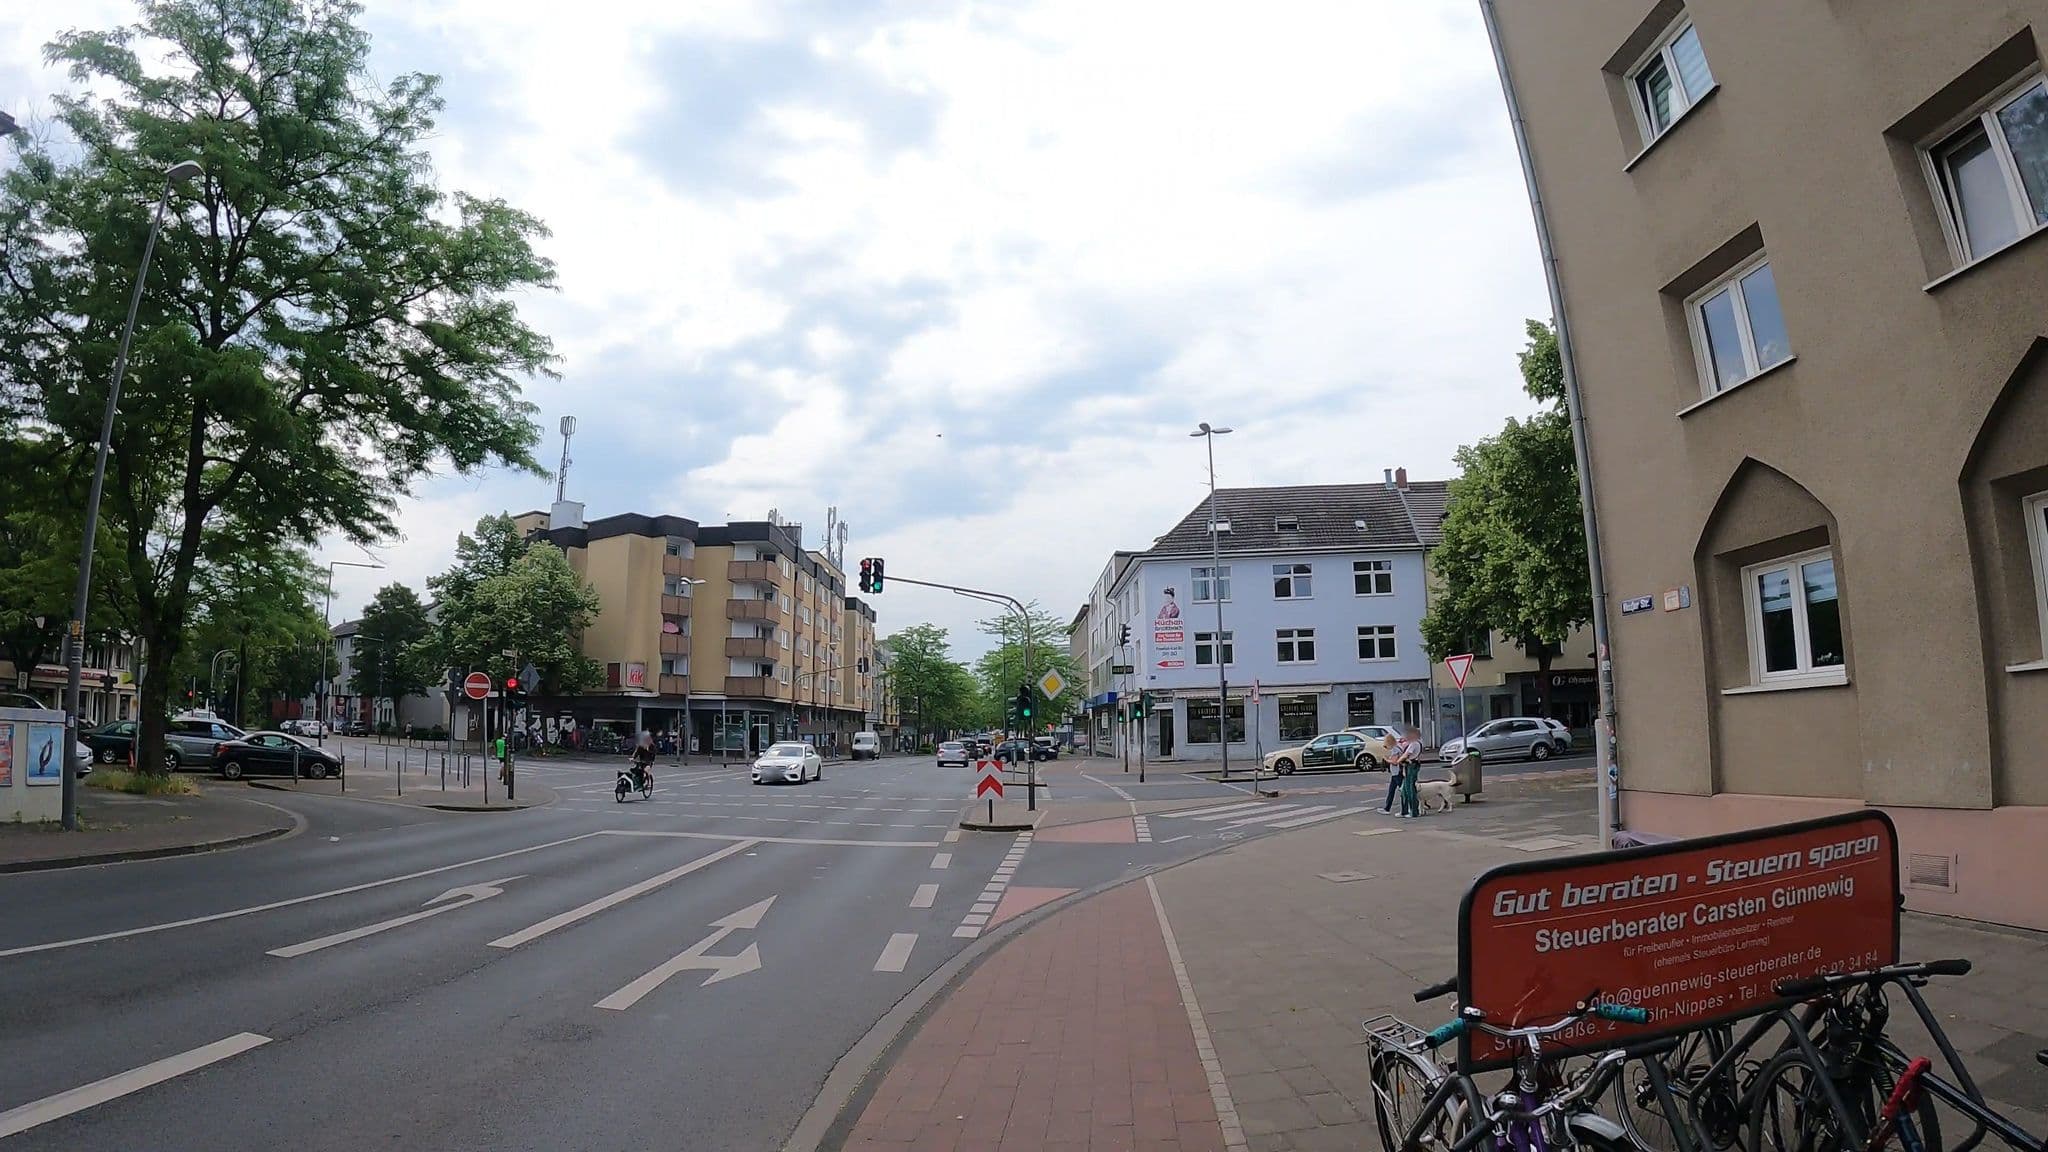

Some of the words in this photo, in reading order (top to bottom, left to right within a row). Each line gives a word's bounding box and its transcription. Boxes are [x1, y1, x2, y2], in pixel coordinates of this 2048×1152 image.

[1492, 887, 1551, 917] Gut
[1561, 873, 1678, 908] beraten
[1705, 851, 1801, 885] Steuern
[1808, 835, 1878, 868] sparen
[1535, 911, 1687, 952] Steuerberater
[1693, 896, 1766, 926] Carsten
[1772, 874, 1854, 909] Günnewig
[1590, 945, 1822, 1006] nfo@guennewig-steuerberater.de
[1623, 946, 1636, 957] für
[1647, 994, 1724, 1023] öln-Nippes
[1865, 949, 1878, 965] 84
